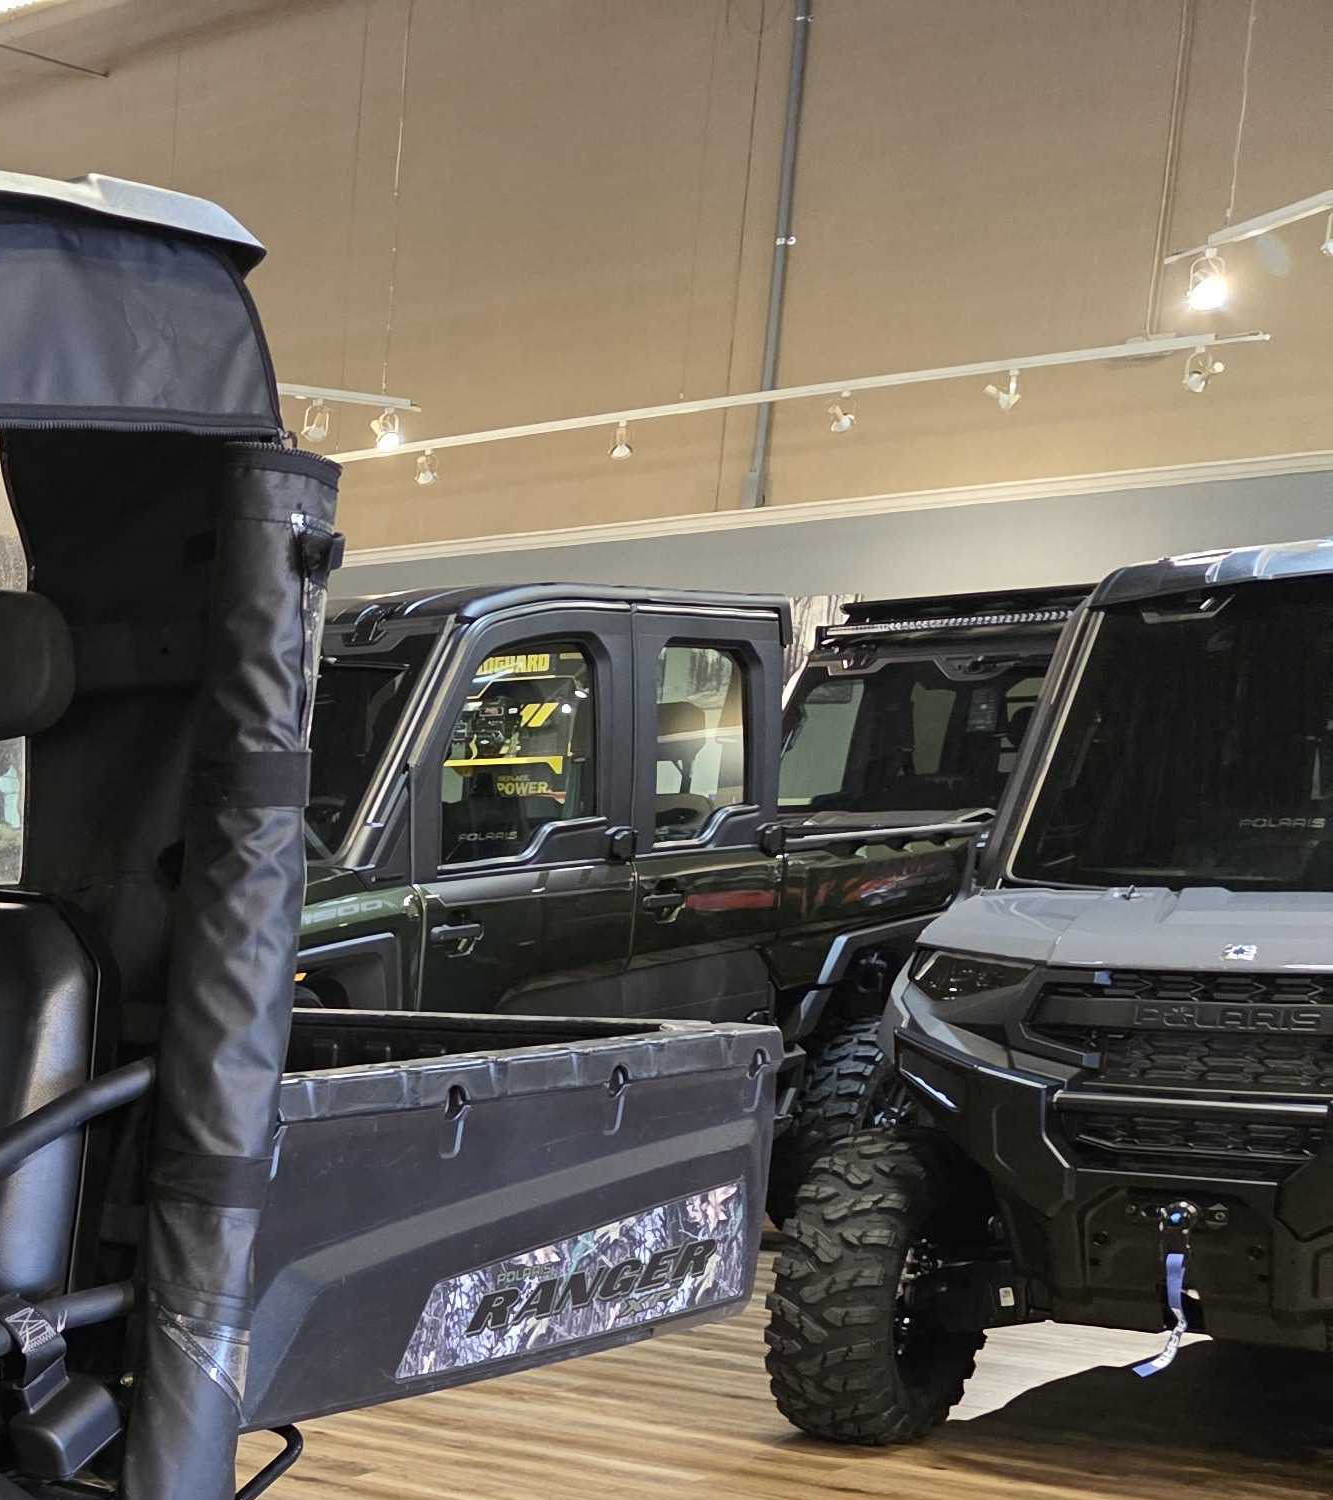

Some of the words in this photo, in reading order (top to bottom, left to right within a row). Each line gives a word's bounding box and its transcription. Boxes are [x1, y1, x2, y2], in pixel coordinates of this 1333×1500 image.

[1237, 817, 1326, 829] POLARIS
[458, 831, 518, 842] POLARIS
[1134, 1004, 1321, 1032] POLARIS
[497, 1263, 552, 1286] POLARIS
[466, 1238, 717, 1338] RANGER
